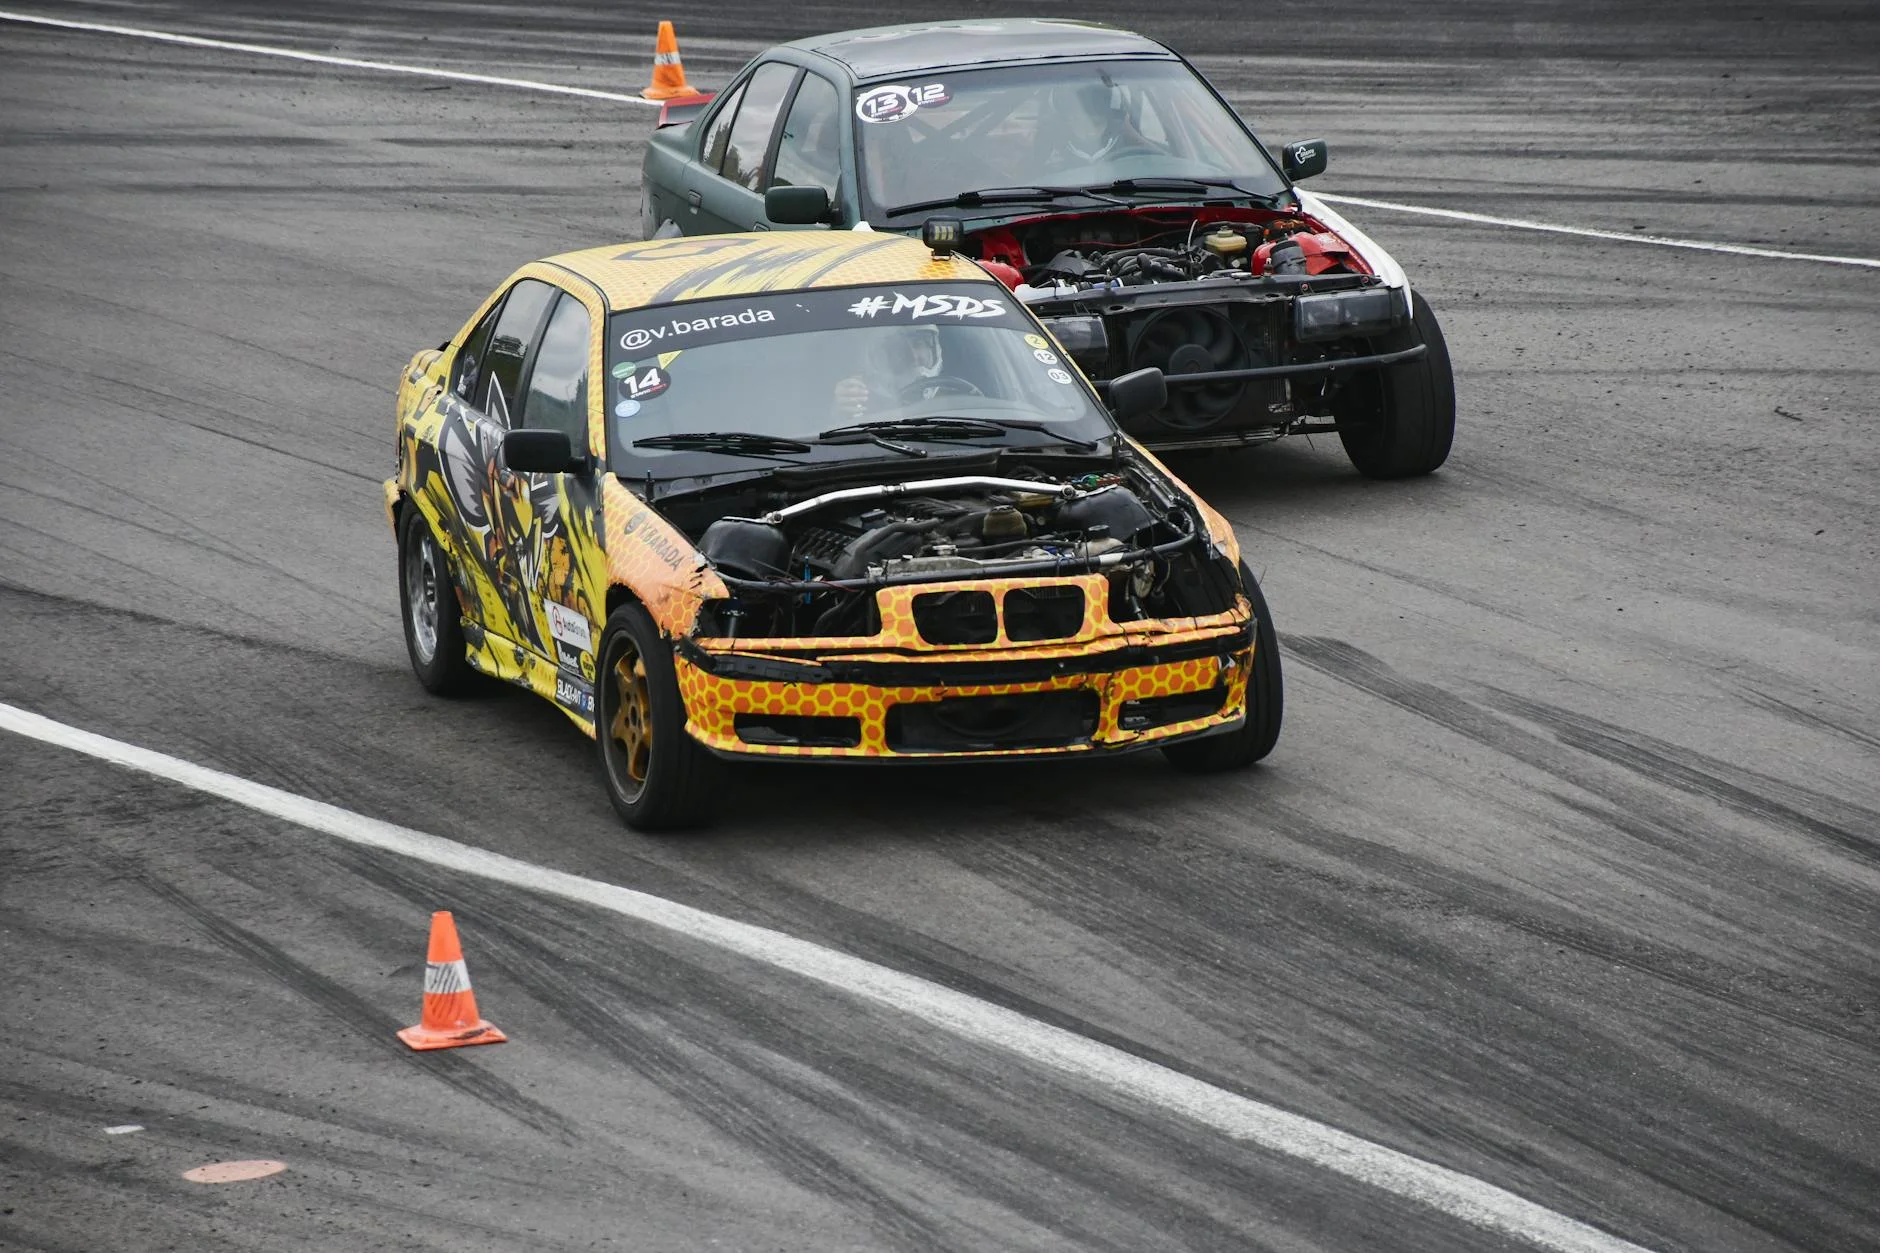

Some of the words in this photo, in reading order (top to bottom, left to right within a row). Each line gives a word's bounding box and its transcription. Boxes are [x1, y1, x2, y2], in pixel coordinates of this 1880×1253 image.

[866, 93, 899, 117] 13
[911, 83, 945, 103] 12
[847, 291, 1007, 320] #MSDS
[619, 308, 776, 350] @v.barada
[1036, 353, 1055, 362] 12
[623, 367, 661, 395] 14
[1050, 372, 1069, 381] 03
